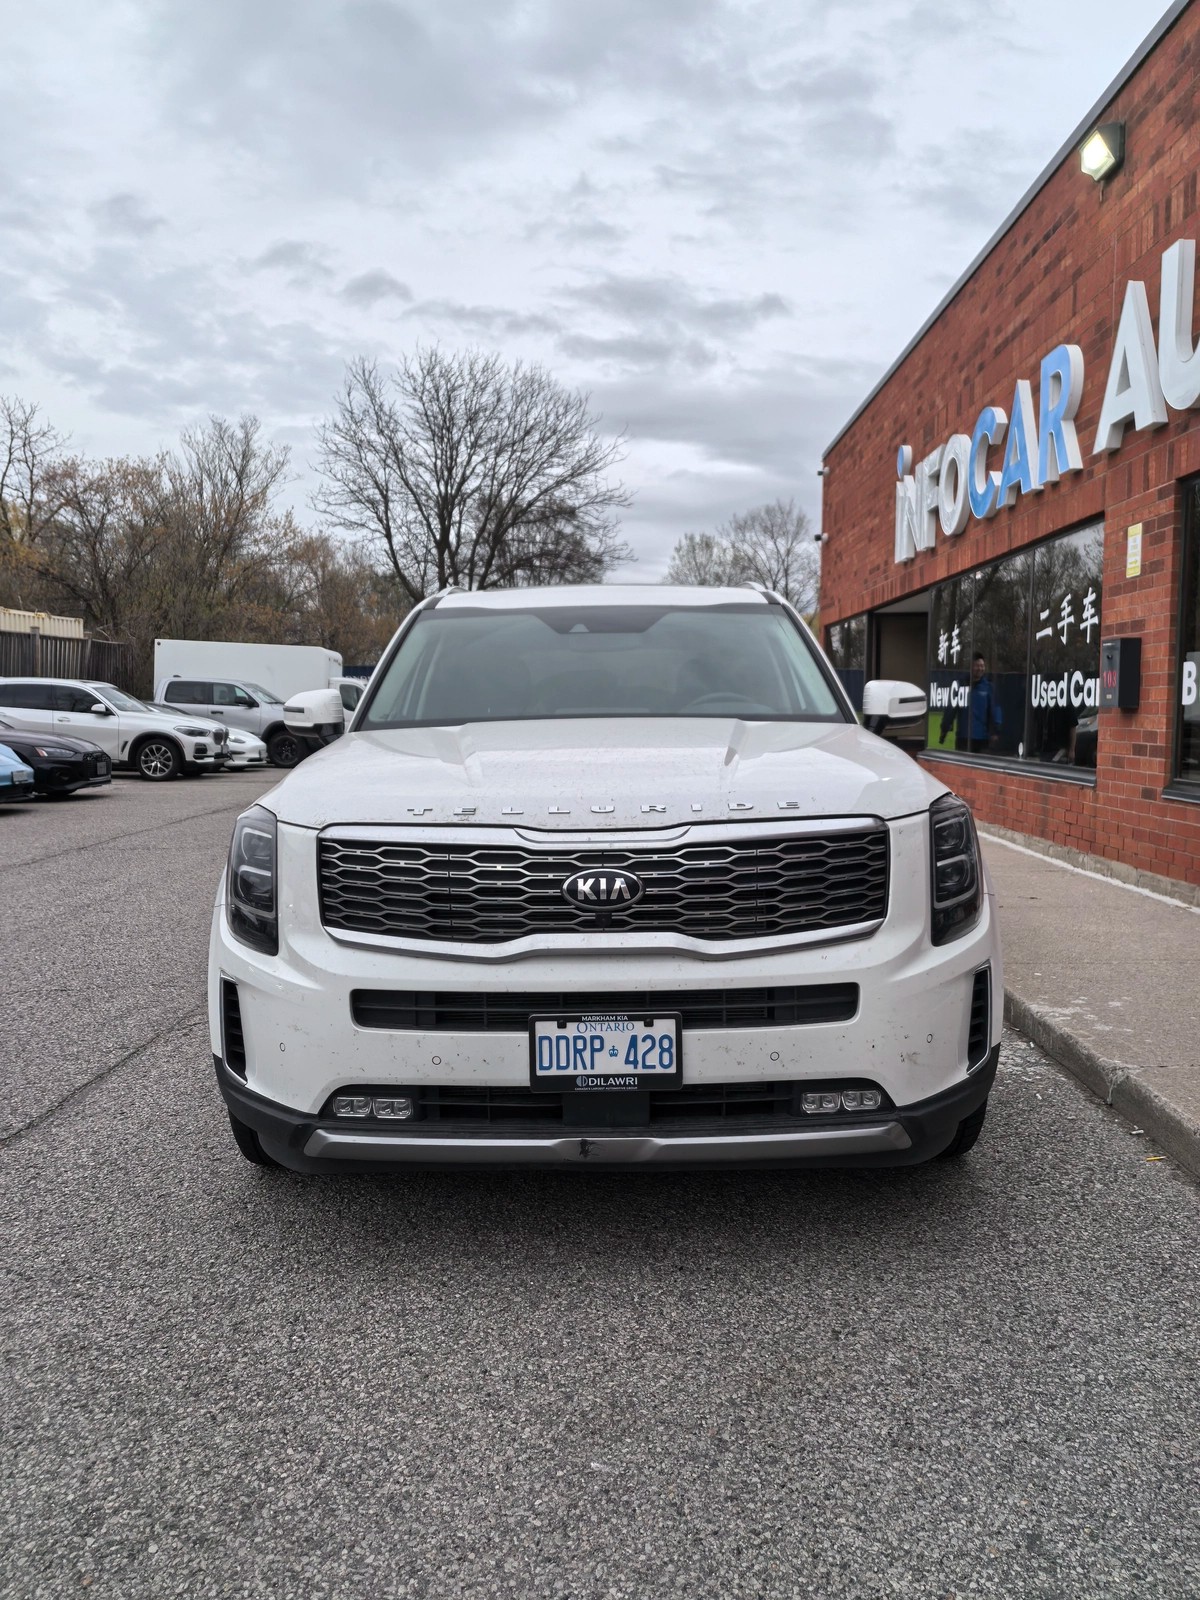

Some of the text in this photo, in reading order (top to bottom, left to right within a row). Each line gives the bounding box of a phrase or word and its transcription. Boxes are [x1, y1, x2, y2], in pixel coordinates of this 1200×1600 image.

[1036, 587, 1099, 645] 二手车
[938, 624, 961, 665] 新车
[1031, 672, 1068, 708] Used
[1103, 671, 1117, 688] 103
[930, 680, 970, 707] New Car
[407, 801, 801, 816] TELLURIDE
[577, 877, 631, 901] KIA
[538, 1034, 674, 1071] DDRP 428
[588, 1076, 638, 1086] DILAWRI
